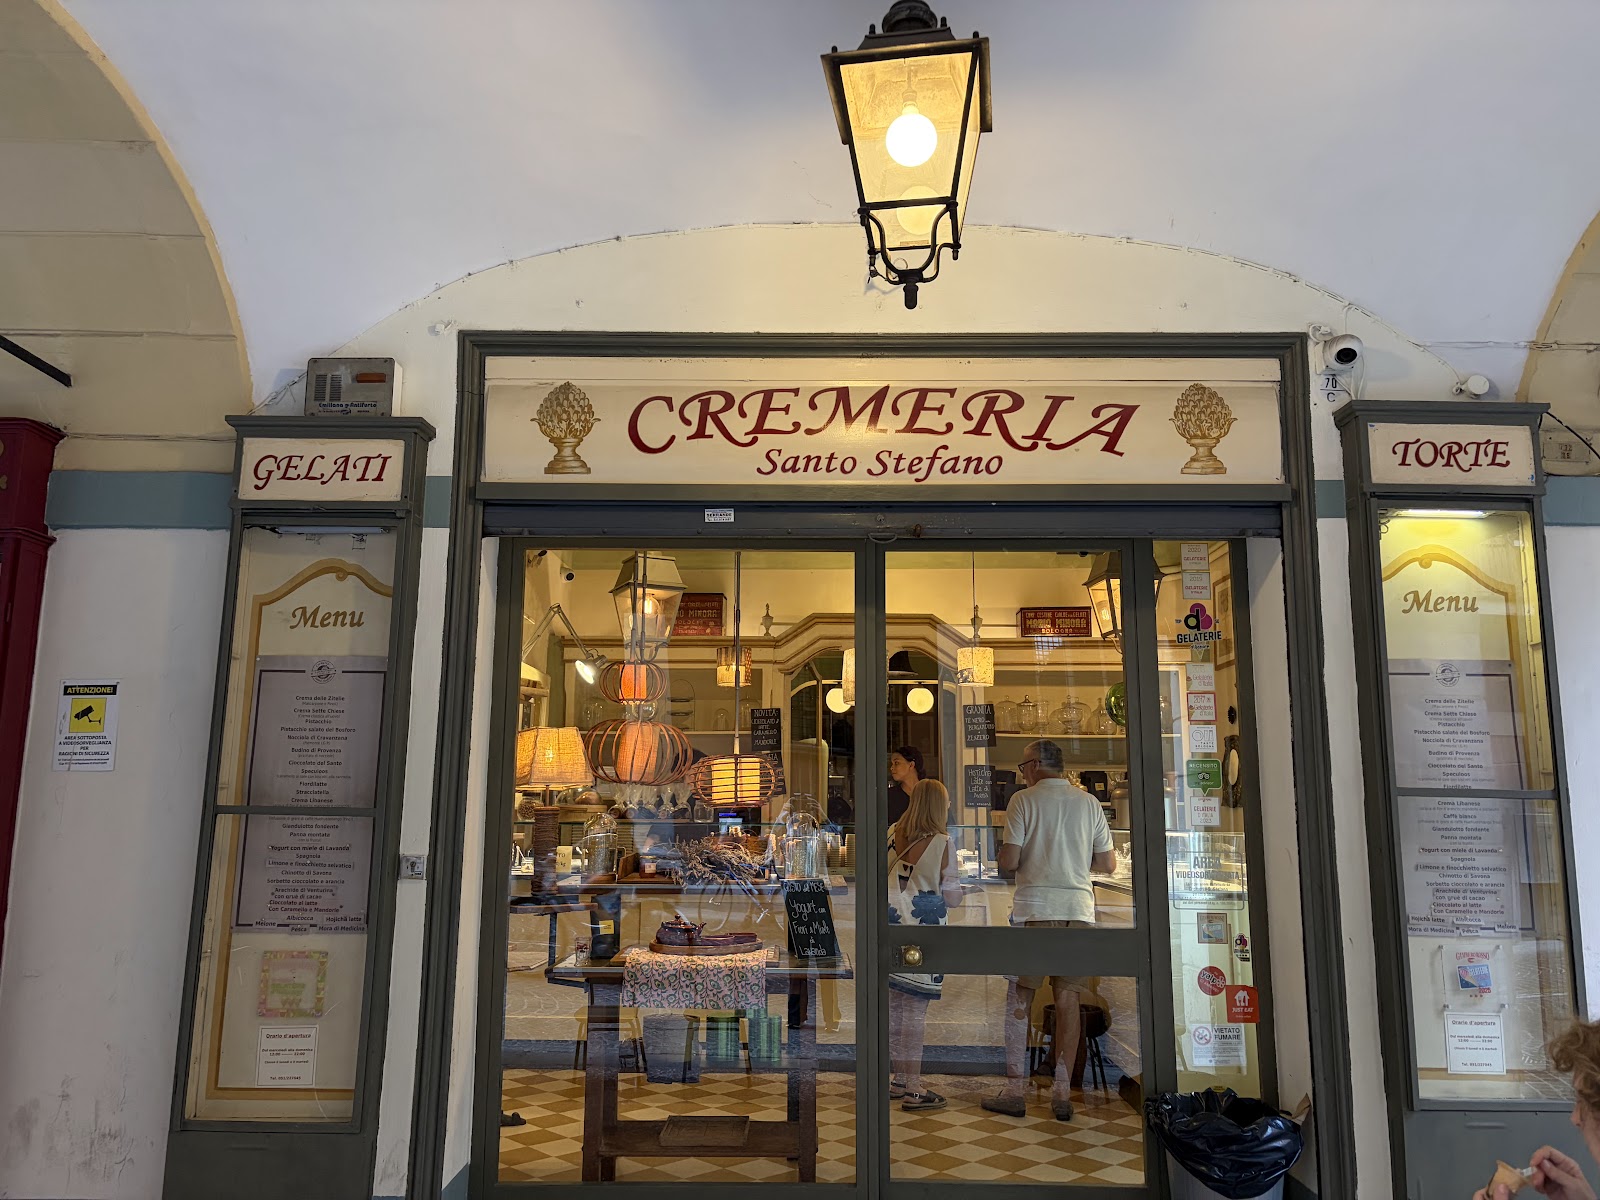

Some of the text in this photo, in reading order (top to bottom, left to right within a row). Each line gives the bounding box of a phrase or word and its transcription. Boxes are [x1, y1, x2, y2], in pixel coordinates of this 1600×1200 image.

[1325, 378, 1337, 388] 70
[1327, 392, 1335, 402] C
[628, 383, 1140, 457] CREMERIA
[757, 445, 1003, 483] Santo Stefano
[1392, 438, 1510, 472] TORTE
[253, 453, 392, 490] GELATI
[1402, 589, 1479, 614] Menu
[289, 606, 364, 629] Menu
[1177, 631, 1222, 643] GELATERIE
[1193, 856, 1222, 868] AREA
[789, 899, 817, 921] Yogurt
[1200, 970, 1216, 984] yelp
